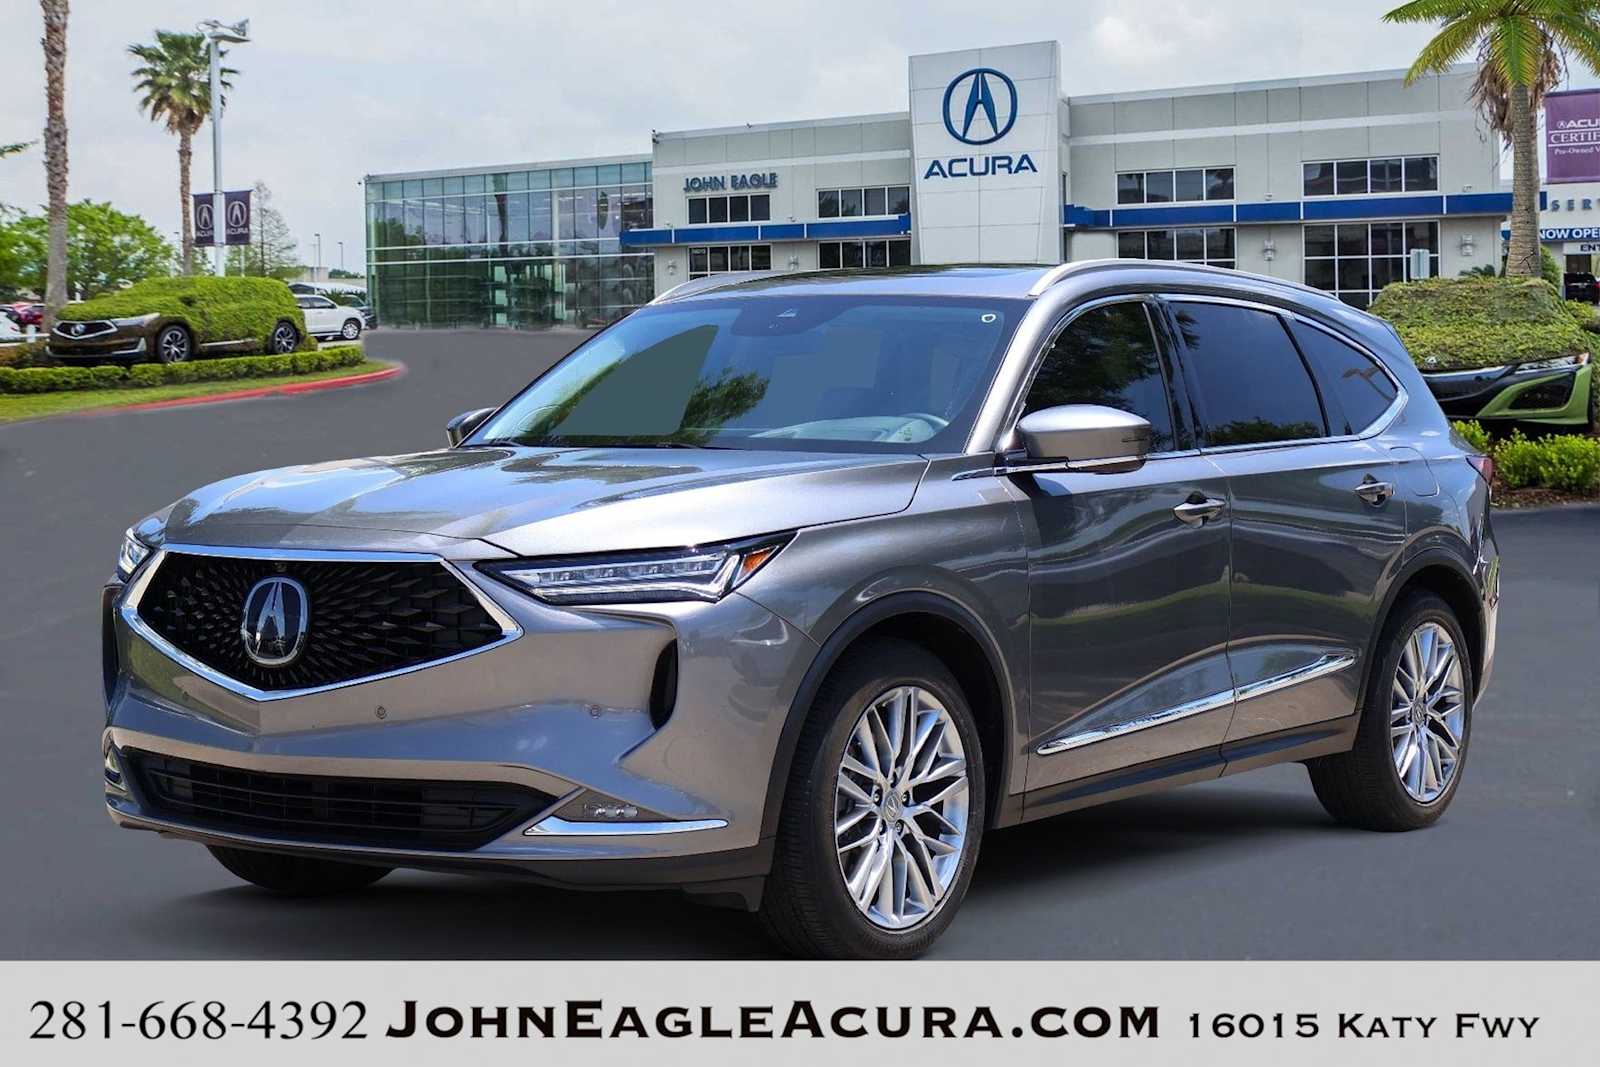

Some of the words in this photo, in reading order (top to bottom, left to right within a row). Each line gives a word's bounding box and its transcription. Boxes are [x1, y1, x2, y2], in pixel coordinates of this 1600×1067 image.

[1567, 119, 1600, 129] ACU
[924, 153, 1038, 179] ACURA
[683, 175, 726, 192] JOHN
[730, 172, 778, 190] EAGLE
[1539, 228, 1570, 239] NOW
[1572, 228, 1600, 238] OPE
